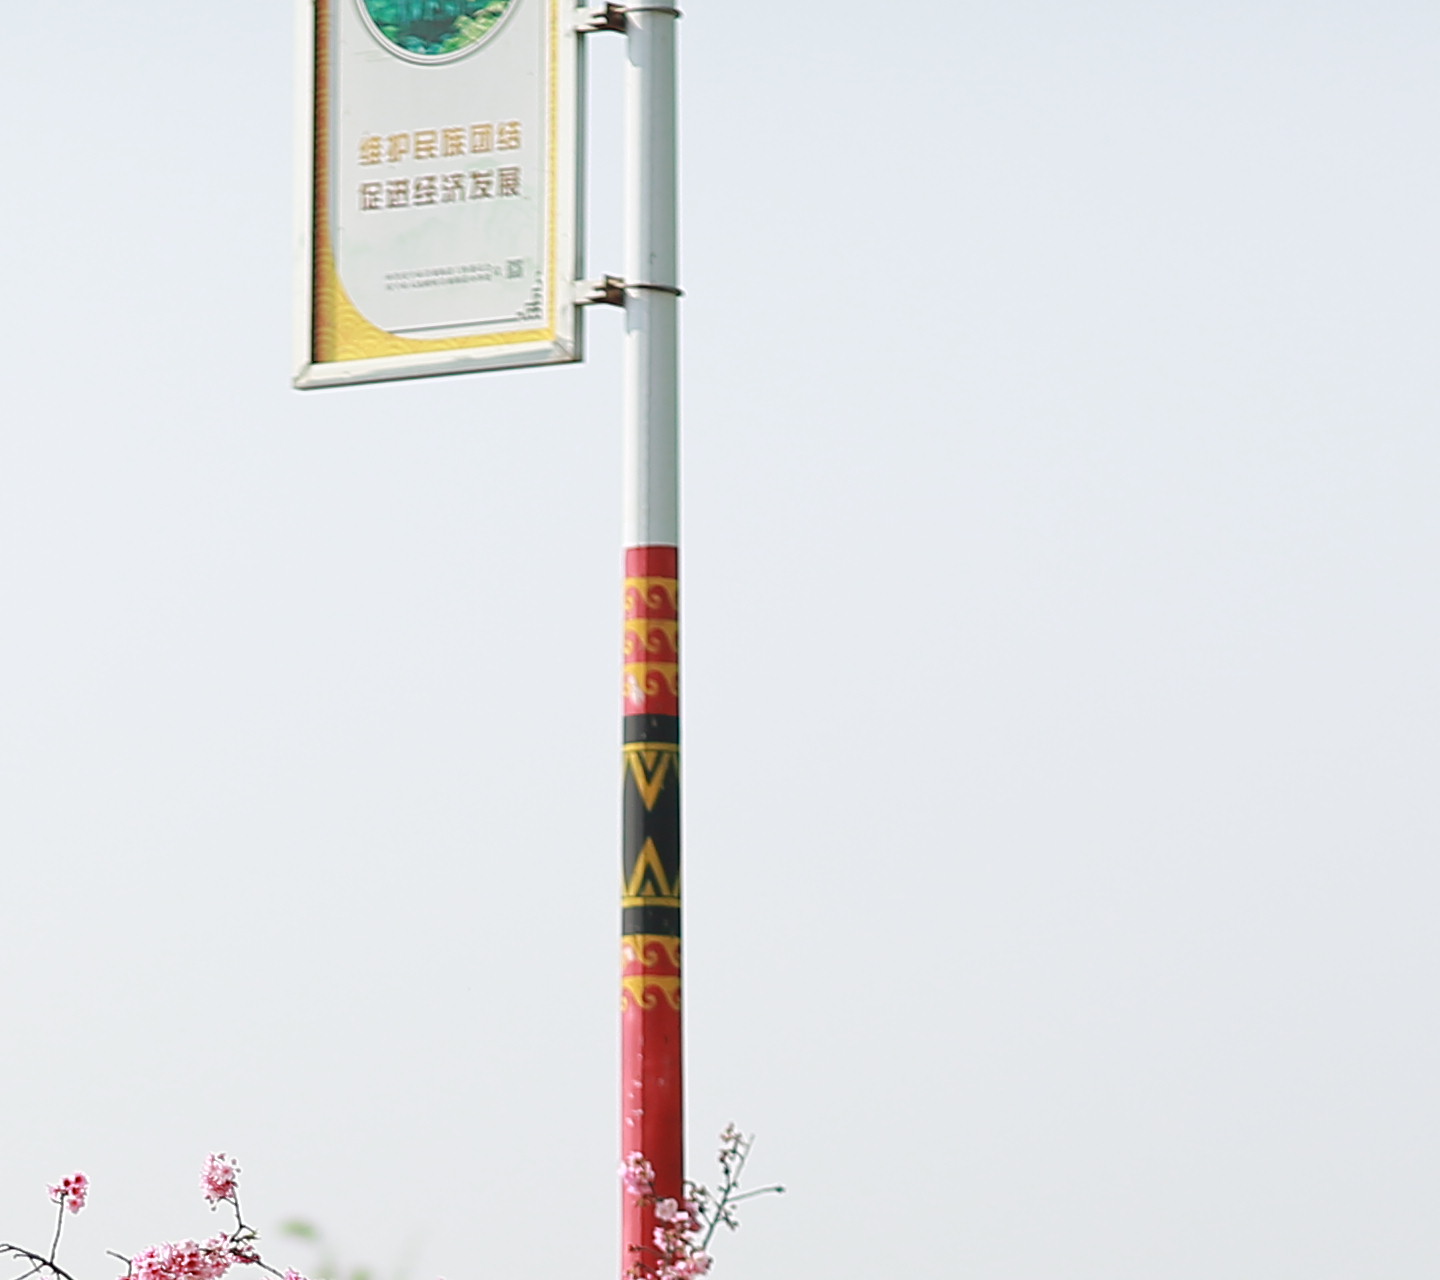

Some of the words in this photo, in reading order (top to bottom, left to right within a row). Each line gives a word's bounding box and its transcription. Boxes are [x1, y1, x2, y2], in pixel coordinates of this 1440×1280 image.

[358, 121, 522, 166] 维护民族团结
[359, 166, 522, 211] 促进经济发展
